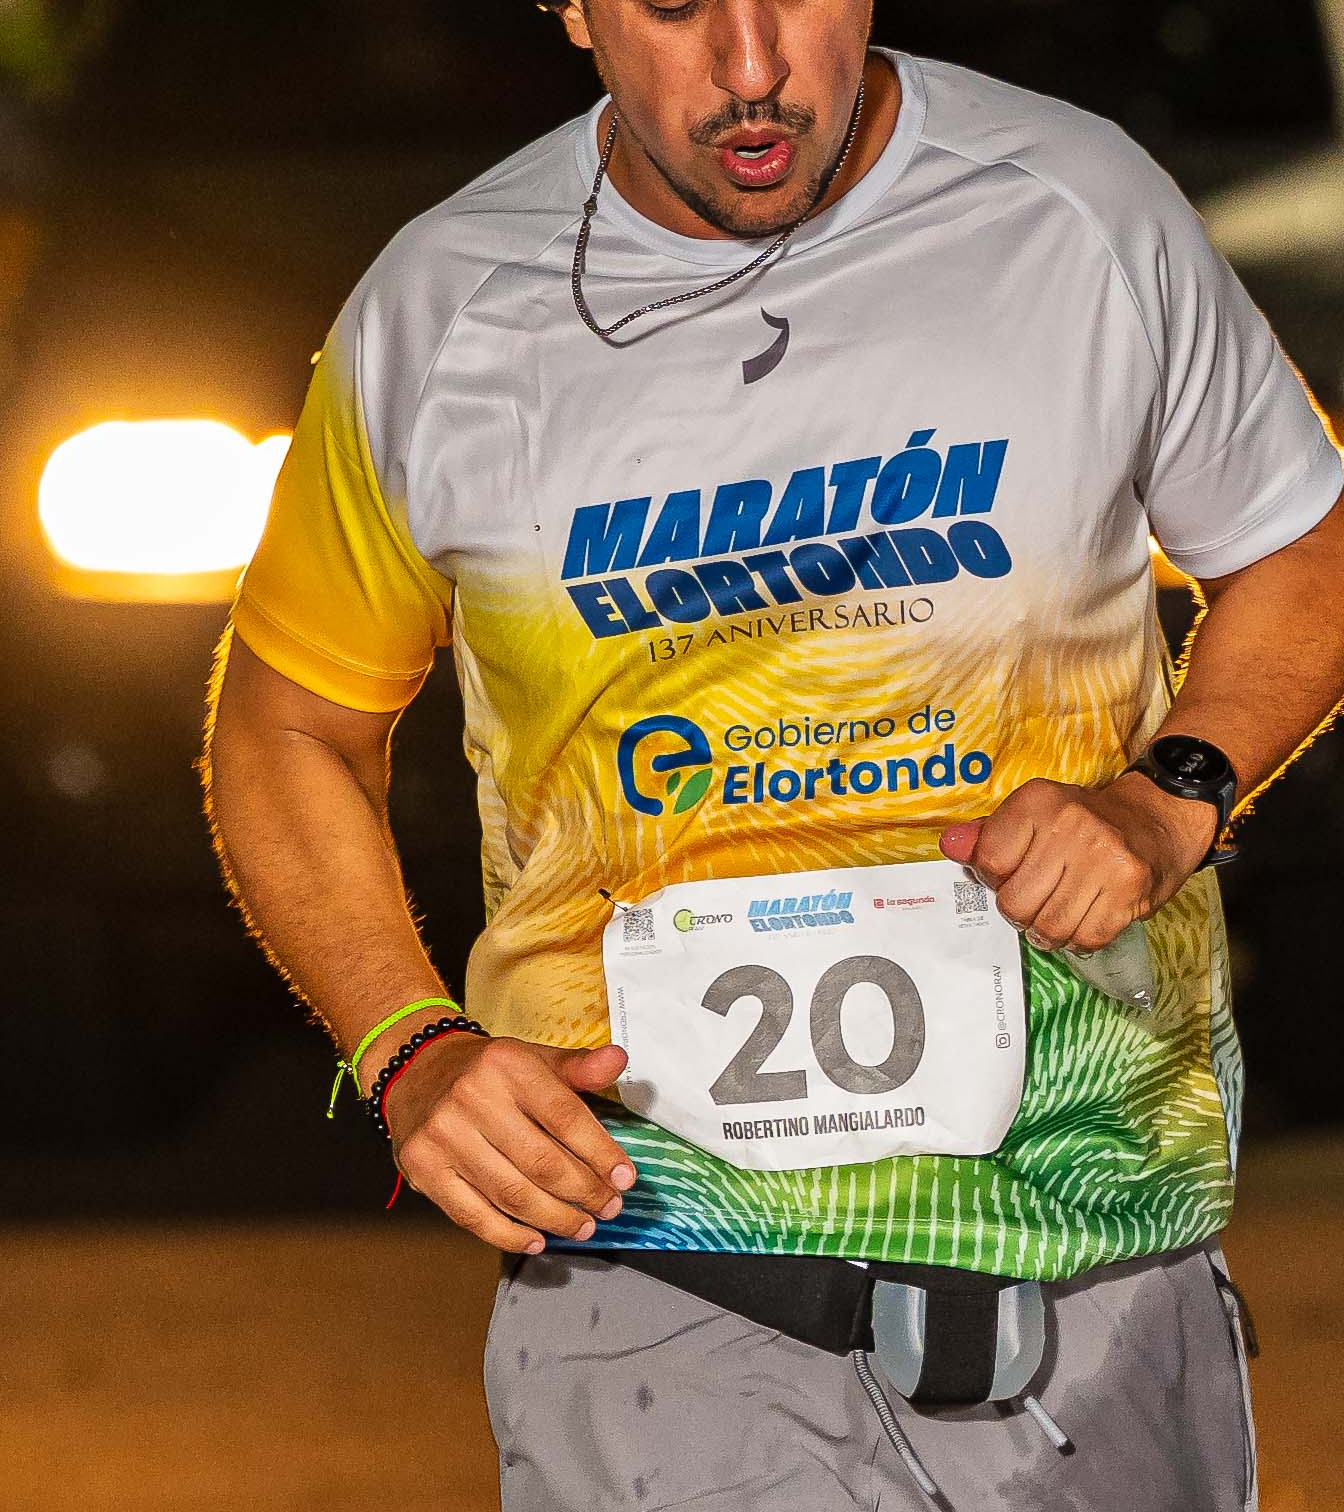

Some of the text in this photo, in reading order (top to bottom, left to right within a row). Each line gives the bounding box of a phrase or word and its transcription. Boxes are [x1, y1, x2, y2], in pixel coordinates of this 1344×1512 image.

[560, 428, 1010, 580] MARATÓN
[565, 520, 1013, 639] ELORTONDO
[648, 597, 935, 663] 137 ANIVERSARIO
[724, 704, 956, 751] Gobierno de
[722, 743, 993, 805] Elortondo
[747, 888, 854, 918] MARATÓN
[701, 955, 925, 1105] 20
[722, 1106, 926, 1141] ROBERTINO MANGIALARDO
